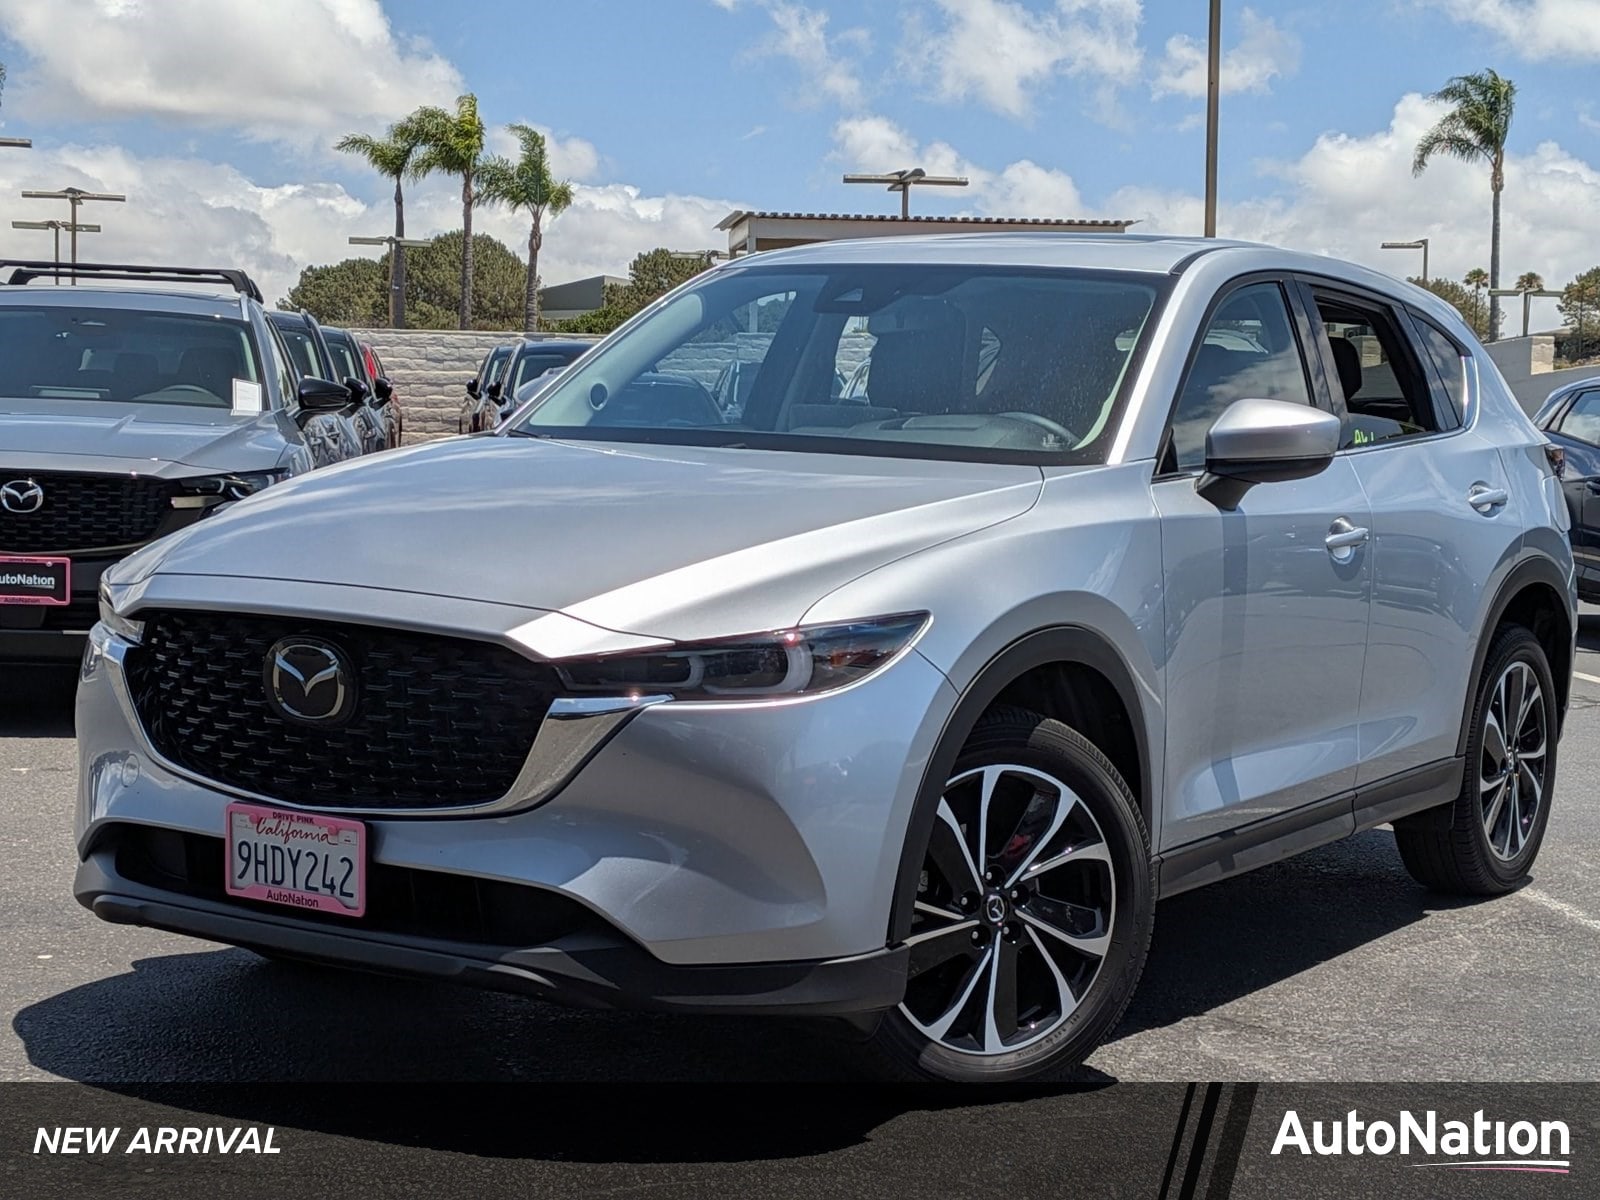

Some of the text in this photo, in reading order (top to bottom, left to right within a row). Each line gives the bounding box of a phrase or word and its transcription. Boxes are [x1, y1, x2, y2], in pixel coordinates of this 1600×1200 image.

[0, 574, 55, 585] utoNation
[272, 811, 315, 825] DRIVE PINK
[256, 817, 338, 845] California
[237, 840, 354, 898] 9HDY242
[266, 890, 319, 908] AutoNation
